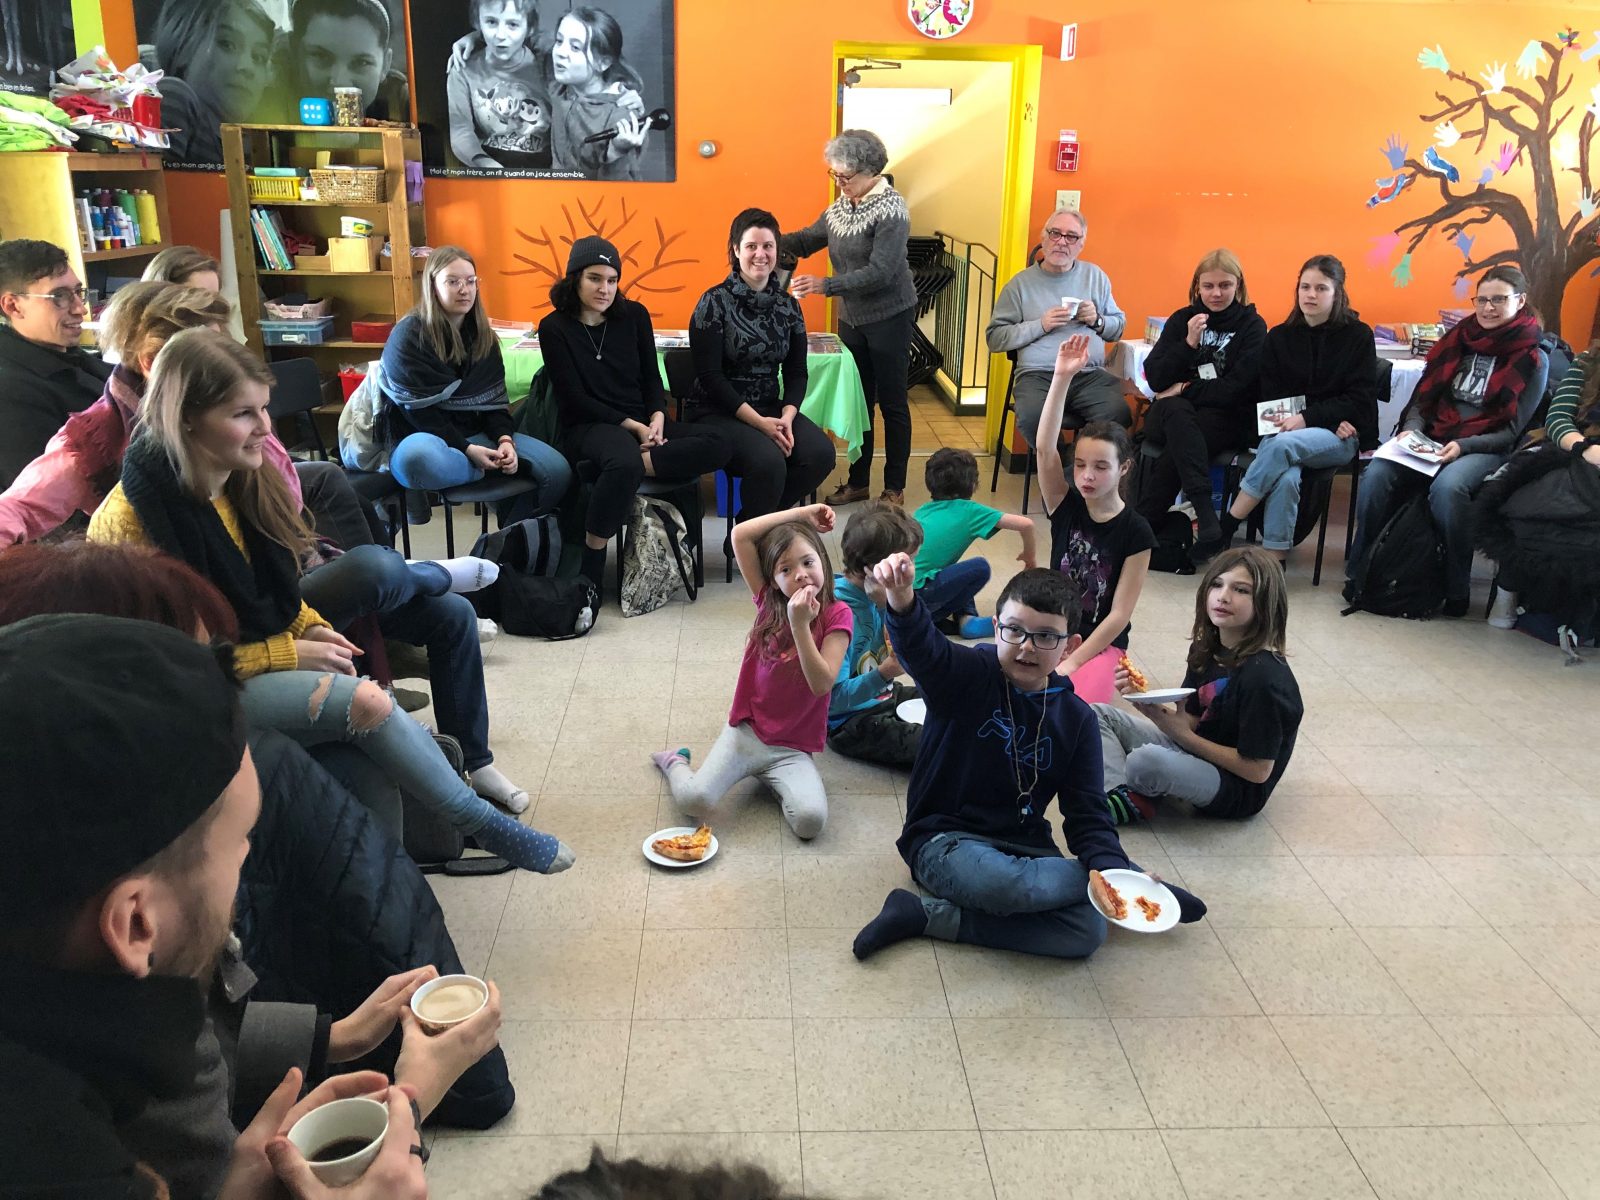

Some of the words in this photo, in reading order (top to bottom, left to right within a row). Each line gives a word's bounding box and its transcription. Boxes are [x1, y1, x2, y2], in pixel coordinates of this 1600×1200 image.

[197, 162, 216, 170] ange
[442, 168, 450, 176] et
[466, 168, 486, 177] frère,
[503, 169, 526, 178] quand
[534, 170, 551, 178] joue
[551, 170, 587, 178] ensemble.
